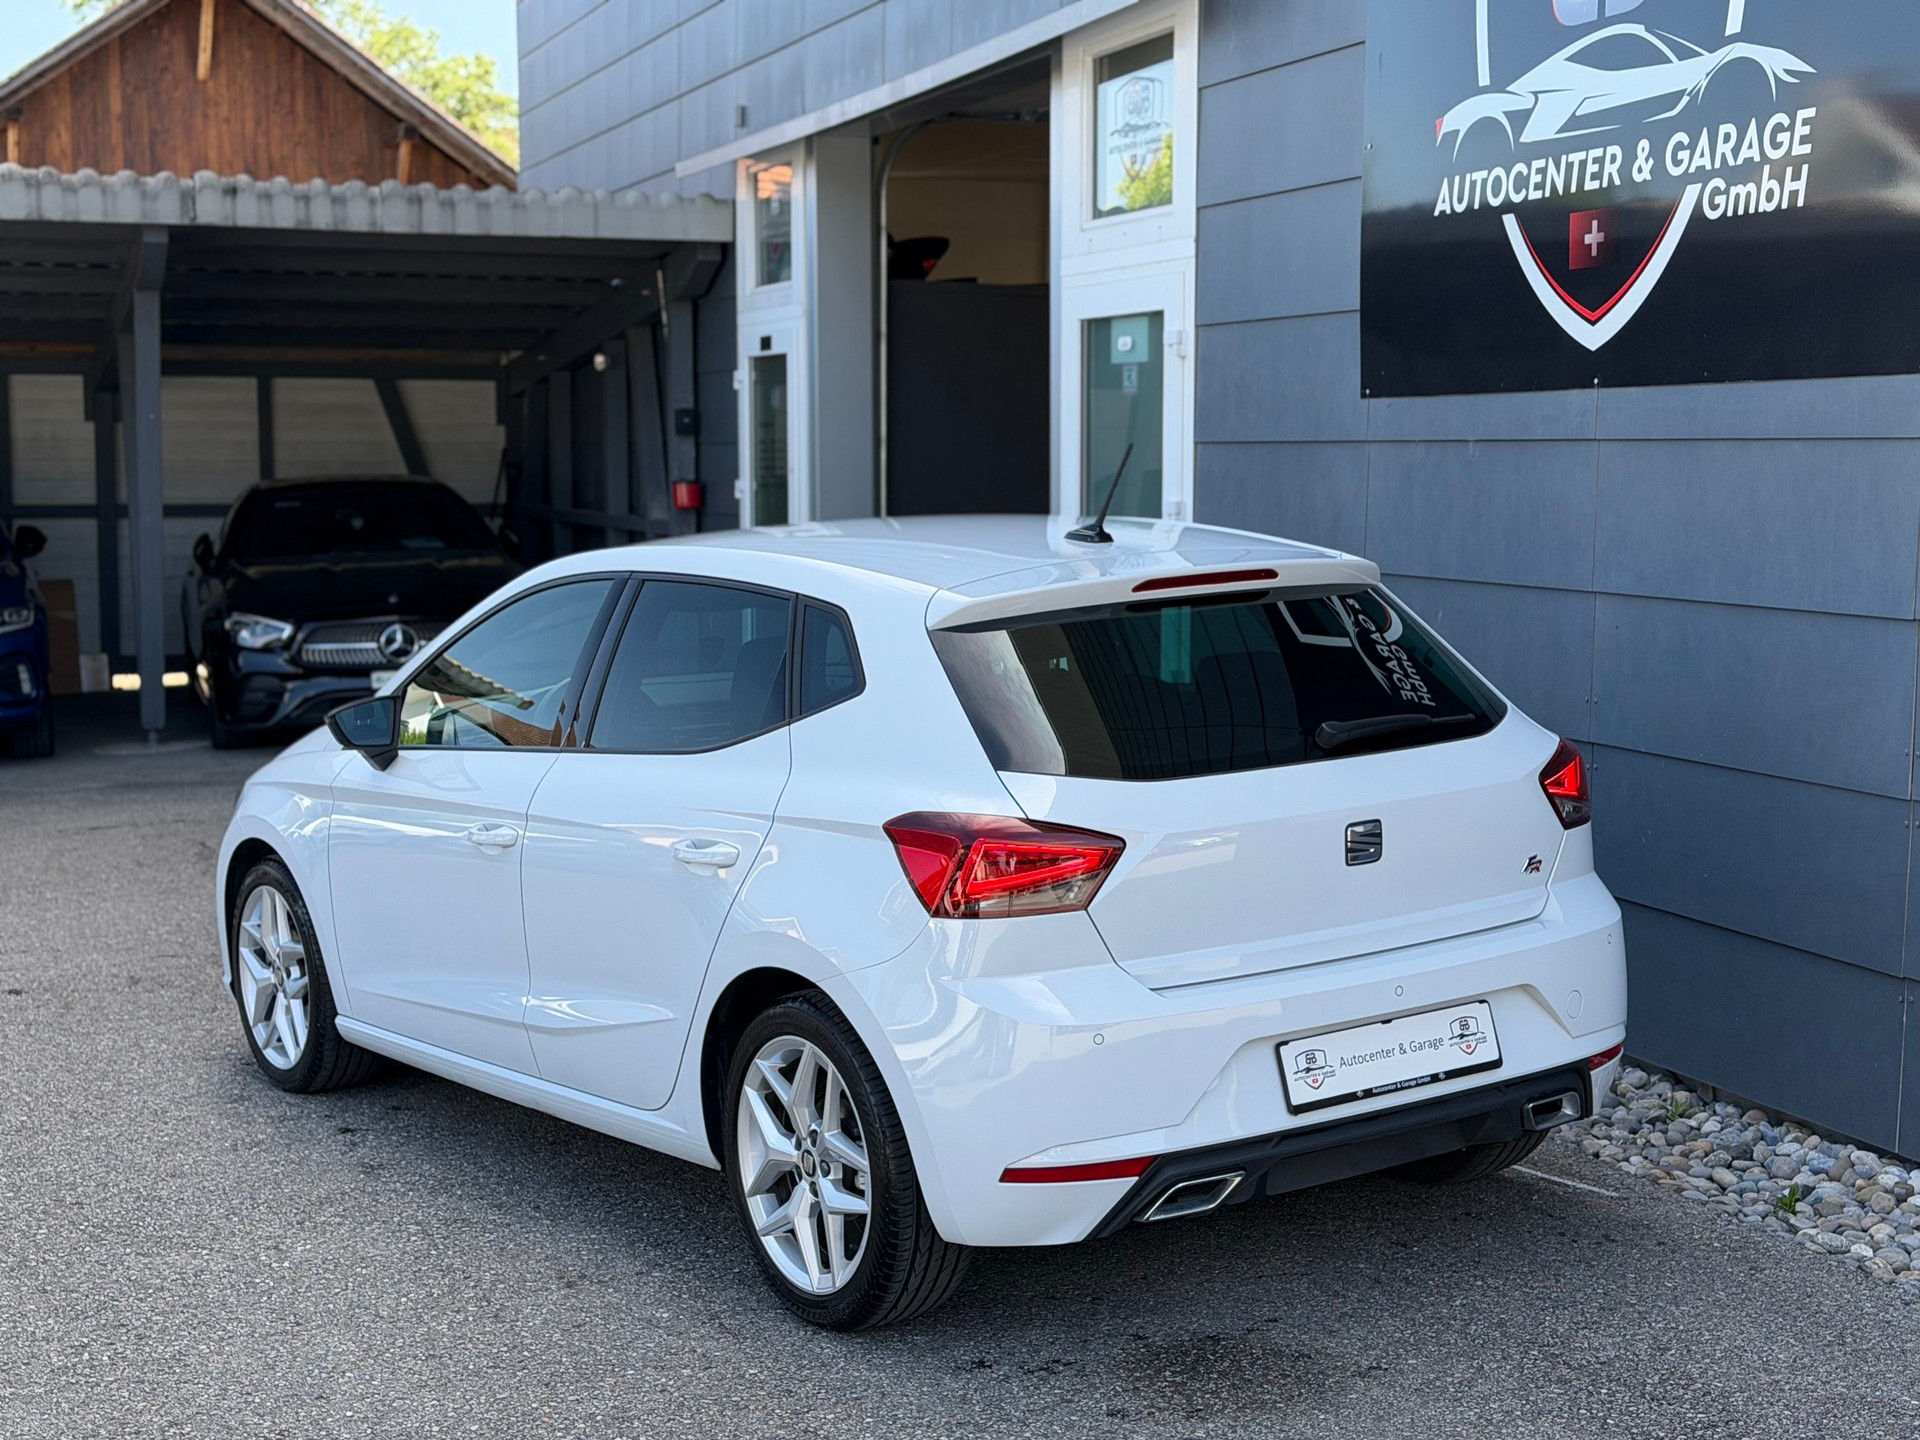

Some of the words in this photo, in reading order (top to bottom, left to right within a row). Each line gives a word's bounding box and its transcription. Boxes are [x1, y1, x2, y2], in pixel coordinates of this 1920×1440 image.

[1434, 145, 1622, 216] AUTOCENTER
[1631, 138, 1654, 182] &
[1665, 107, 1816, 176] GARAGE
[1702, 163, 1809, 220] GmbH
[1339, 1046, 1395, 1069] Autocenter
[1398, 1042, 1408, 1055] &
[1409, 1037, 1445, 1051] Garage
[1372, 1084, 1397, 1094] Autocenter
[1401, 1079, 1417, 1088] Garage
